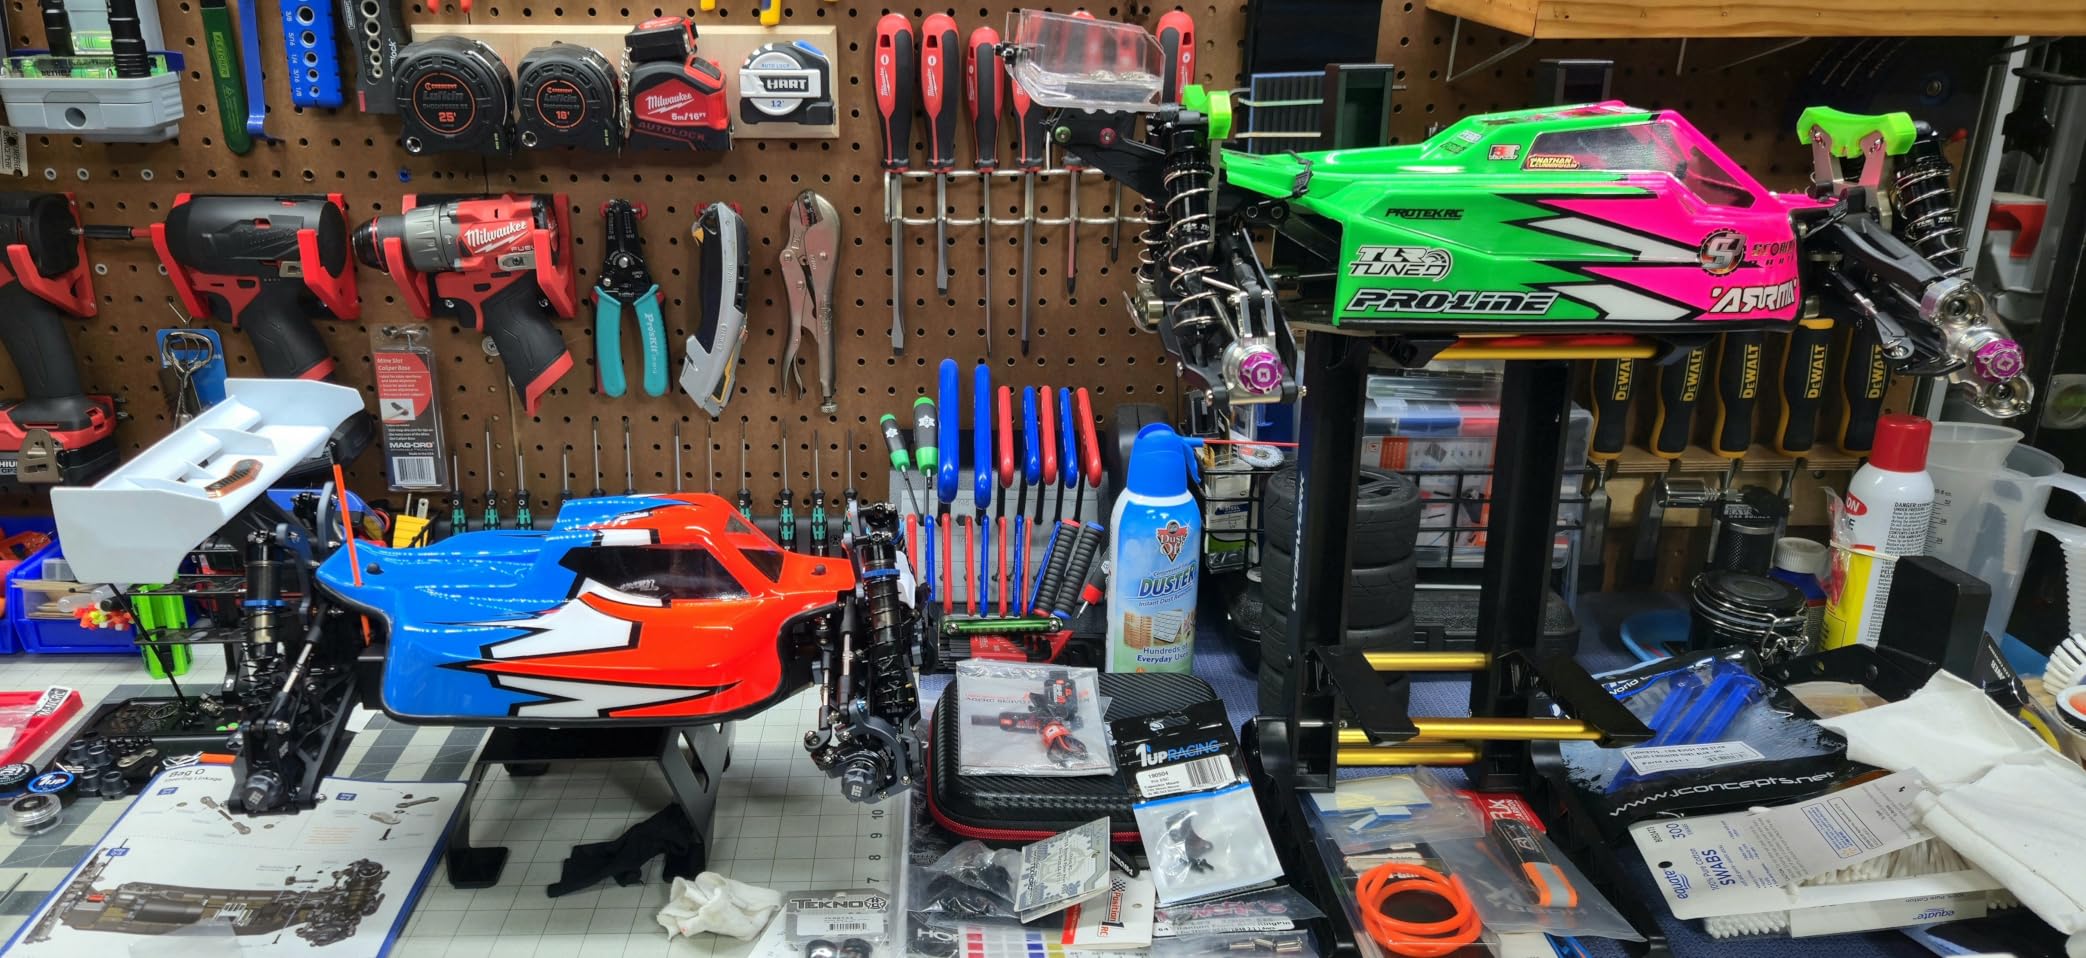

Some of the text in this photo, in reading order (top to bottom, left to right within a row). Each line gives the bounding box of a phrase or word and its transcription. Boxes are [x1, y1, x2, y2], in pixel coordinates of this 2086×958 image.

[287, 32, 295, 47] 5/16
[292, 68, 300, 83] 3/16
[767, 79, 807, 90] HART
[645, 92, 694, 109] Milwaukee
[438, 111, 457, 123] 25'
[638, 122, 705, 141] AUTOLOCK
[464, 221, 528, 248] Milwaukee
[1357, 246, 1429, 264] TLR
[1350, 263, 1450, 277] TUNED
[1160, 534, 1185, 545] Dust
[1159, 543, 1183, 556] Off
[1138, 565, 1197, 598] DUSTER
[1143, 646, 1181, 655] Hundreds
[1136, 654, 1173, 664] Everyday
[168, 770, 193, 778] Bag
[1609, 770, 1835, 817] www.jconcepts.net
[871, 809, 885, 820] 10
[1665, 822, 1686, 840] 300
[1689, 848, 1704, 866] Cotton
[1701, 848, 1737, 887] SWABS
[1664, 870, 1690, 900] equate
[790, 898, 864, 910] TEKNO
[1108, 891, 1121, 922] Position
[1917, 909, 1955, 921] equate
[1099, 926, 1109, 937] RC
